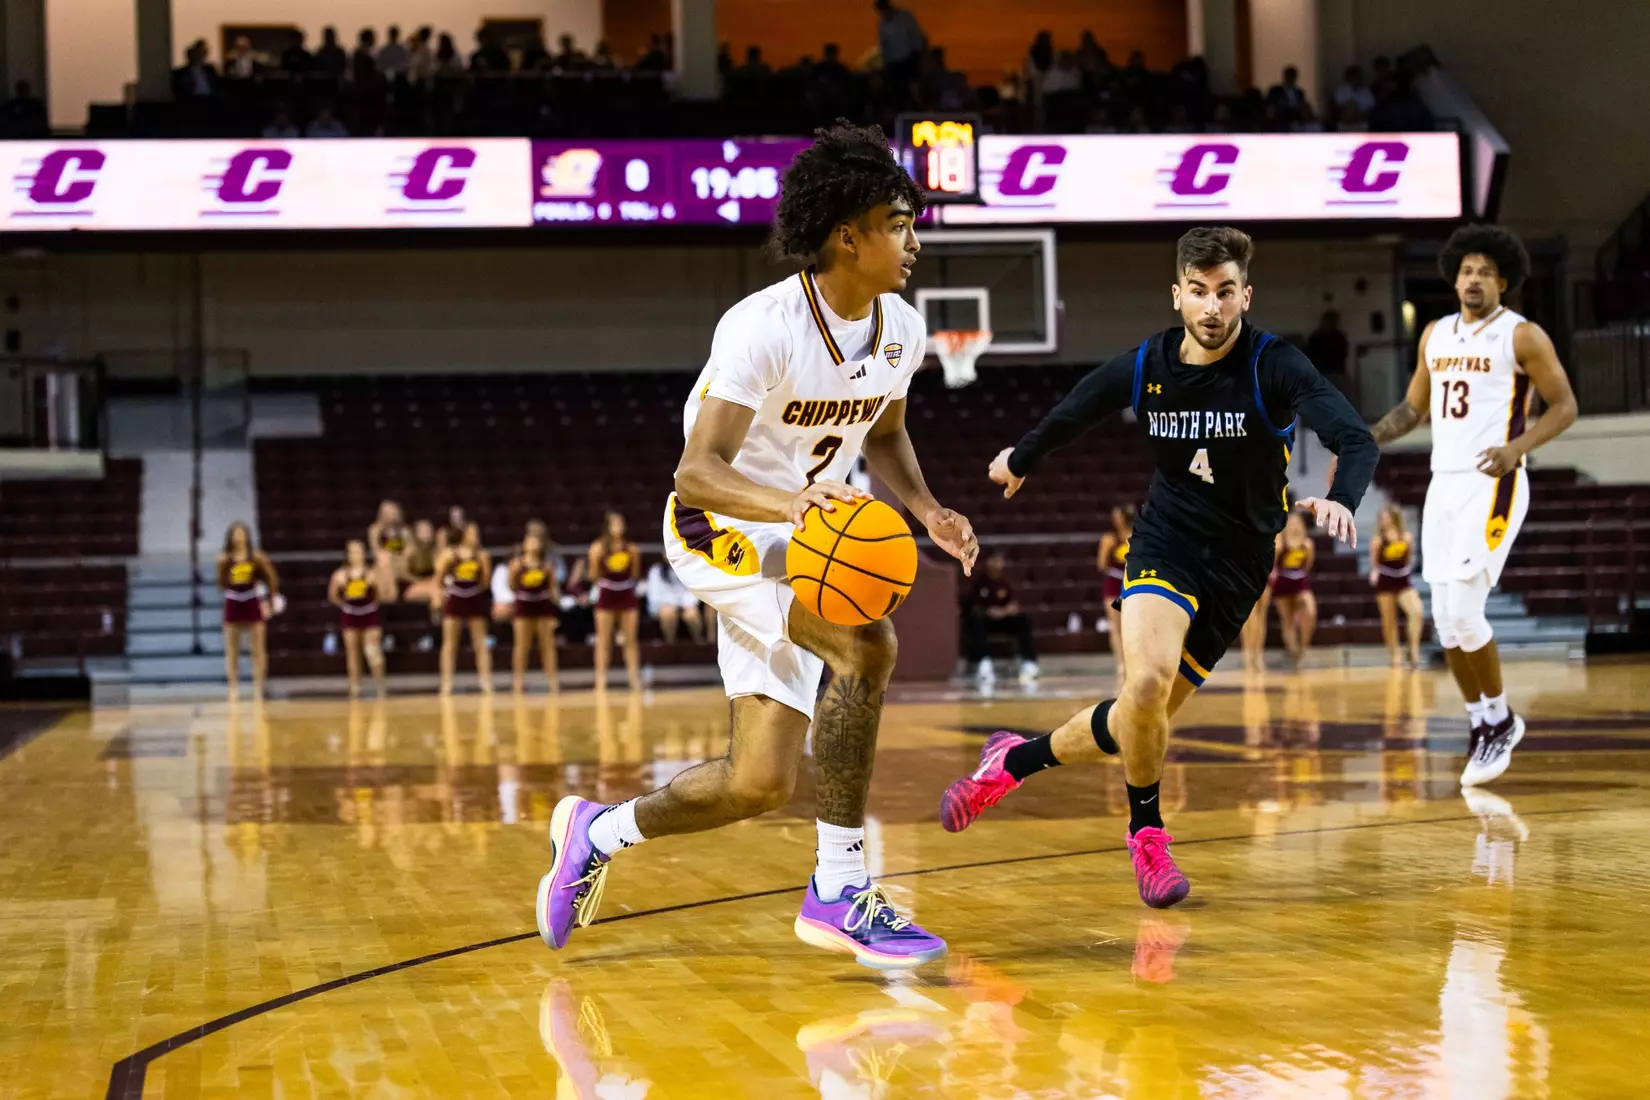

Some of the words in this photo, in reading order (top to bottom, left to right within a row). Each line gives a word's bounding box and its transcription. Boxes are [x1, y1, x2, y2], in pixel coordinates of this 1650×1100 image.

[29, 149, 106, 203] C
[217, 149, 293, 202] C
[403, 147, 476, 200] C
[928, 149, 966, 191] 18
[998, 145, 1067, 196] C
[1171, 144, 1240, 195] C
[1341, 142, 1409, 192] C
[1147, 411, 1200, 439] NORTH
[1205, 411, 1247, 438] PARK
[1442, 380, 1469, 419] 13
[801, 434, 843, 491] 2
[1188, 448, 1215, 484] 4
